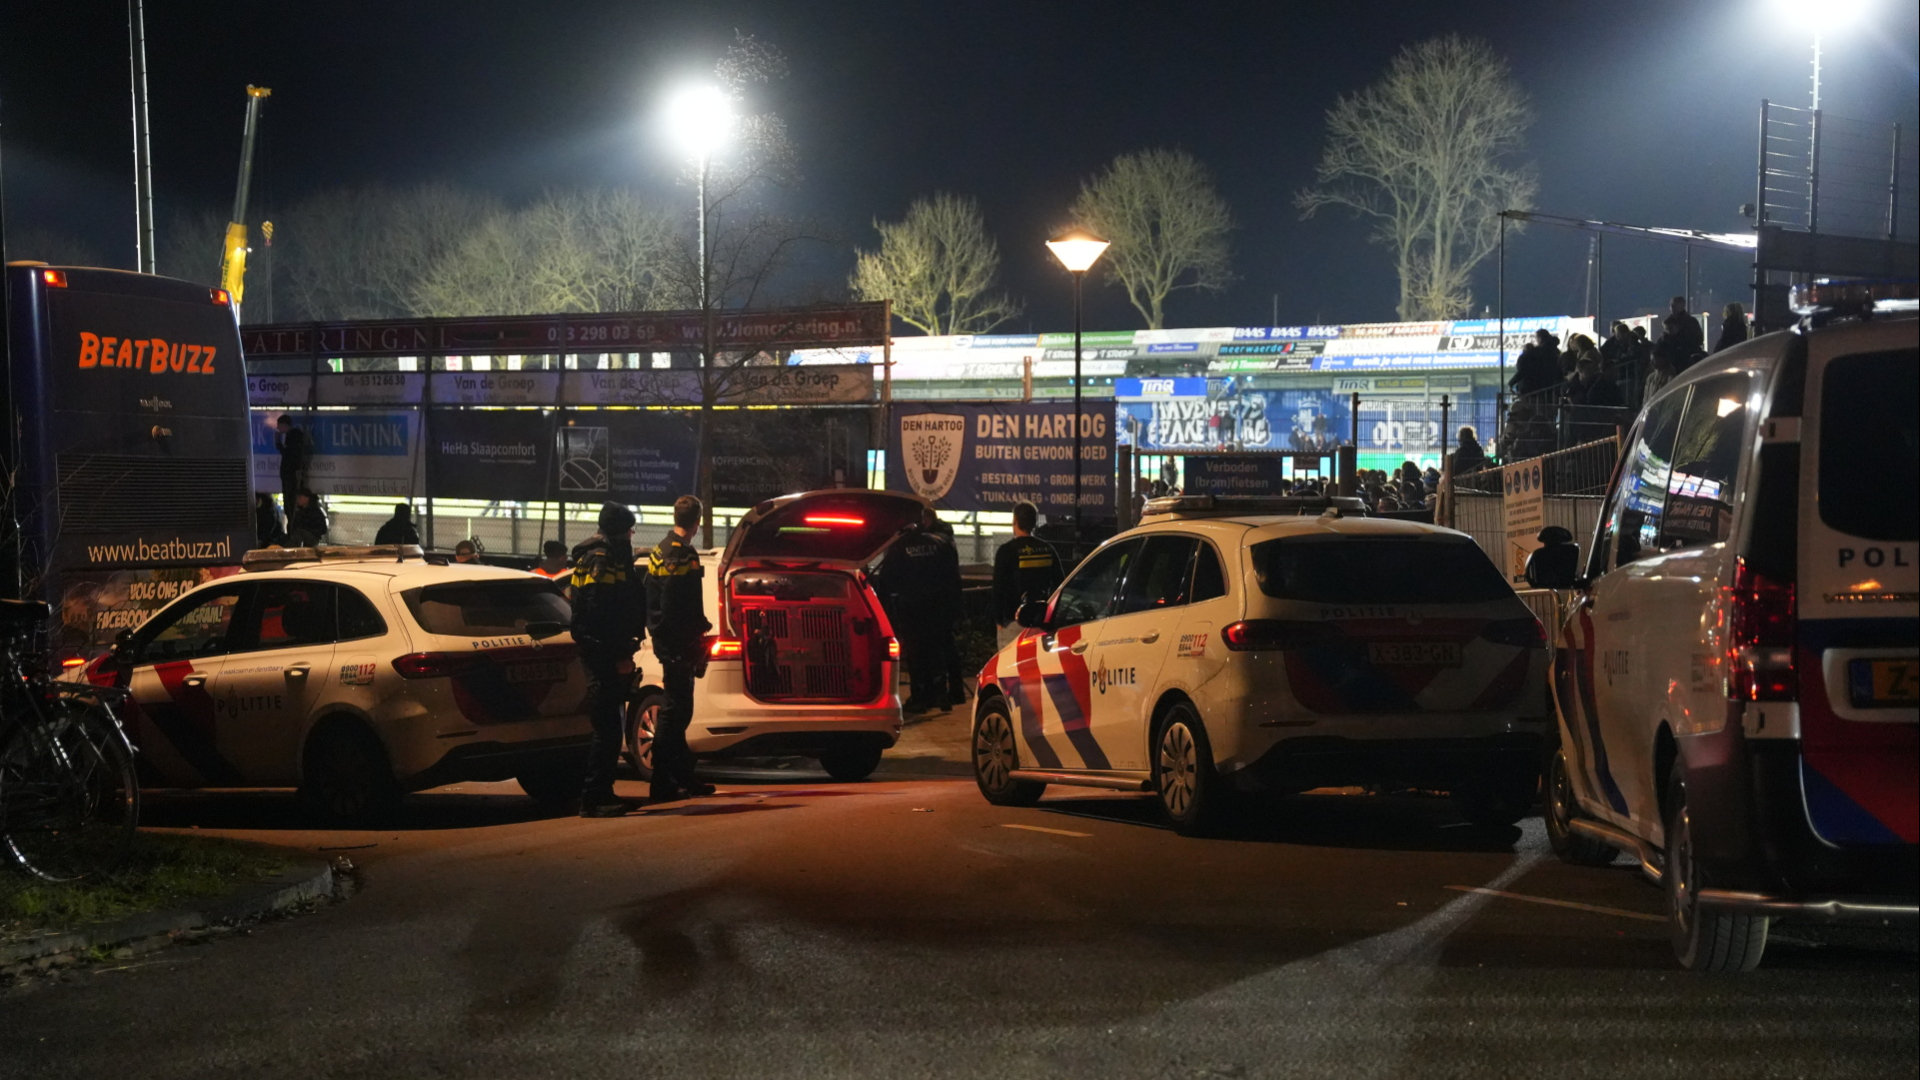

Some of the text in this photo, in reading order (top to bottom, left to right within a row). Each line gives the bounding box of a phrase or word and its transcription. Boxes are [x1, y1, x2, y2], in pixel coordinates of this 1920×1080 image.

[1234, 327, 1266, 338] BAAS
[1270, 327, 1302, 337] BAAS
[1307, 326, 1339, 337] BAAS
[241, 326, 450, 353] ATERING.NL
[580, 326, 607, 340] 298
[612, 326, 630, 339] 03
[1219, 343, 1283, 354] meerwaerde
[372, 375, 382, 386] 12
[383, 374, 393, 385] 66
[394, 373, 406, 385] 30
[454, 374, 535, 393] Van de Groep
[591, 374, 616, 388] Van
[773, 369, 790, 386] de
[794, 370, 839, 389] Groep
[258, 378, 288, 396] Groep
[903, 420, 963, 432] DEN HARTOG
[976, 414, 1020, 439] DEN
[1025, 413, 1107, 439] HARTOG
[332, 423, 403, 447] LENTINK
[442, 441, 536, 458] HeHa Slaapcomfort
[975, 445, 1021, 460] BUITEN
[1023, 446, 1074, 460] GEWOON
[1205, 461, 1258, 473] Verboden
[981, 473, 1107, 487] BESTRATING GRONWERK
[1195, 475, 1269, 489] (brom)fietsen
[88, 536, 231, 563] www.beatbuzz.nl
[130, 580, 194, 600] VOLG ONS OP
[97, 609, 149, 629] FACEBOOK
[472, 636, 525, 649] POLITIE
[1193, 633, 1208, 648] 112
[341, 663, 376, 676] 0900 112
[1092, 666, 1136, 694] POLITIE
[217, 692, 282, 718] POLITIE
